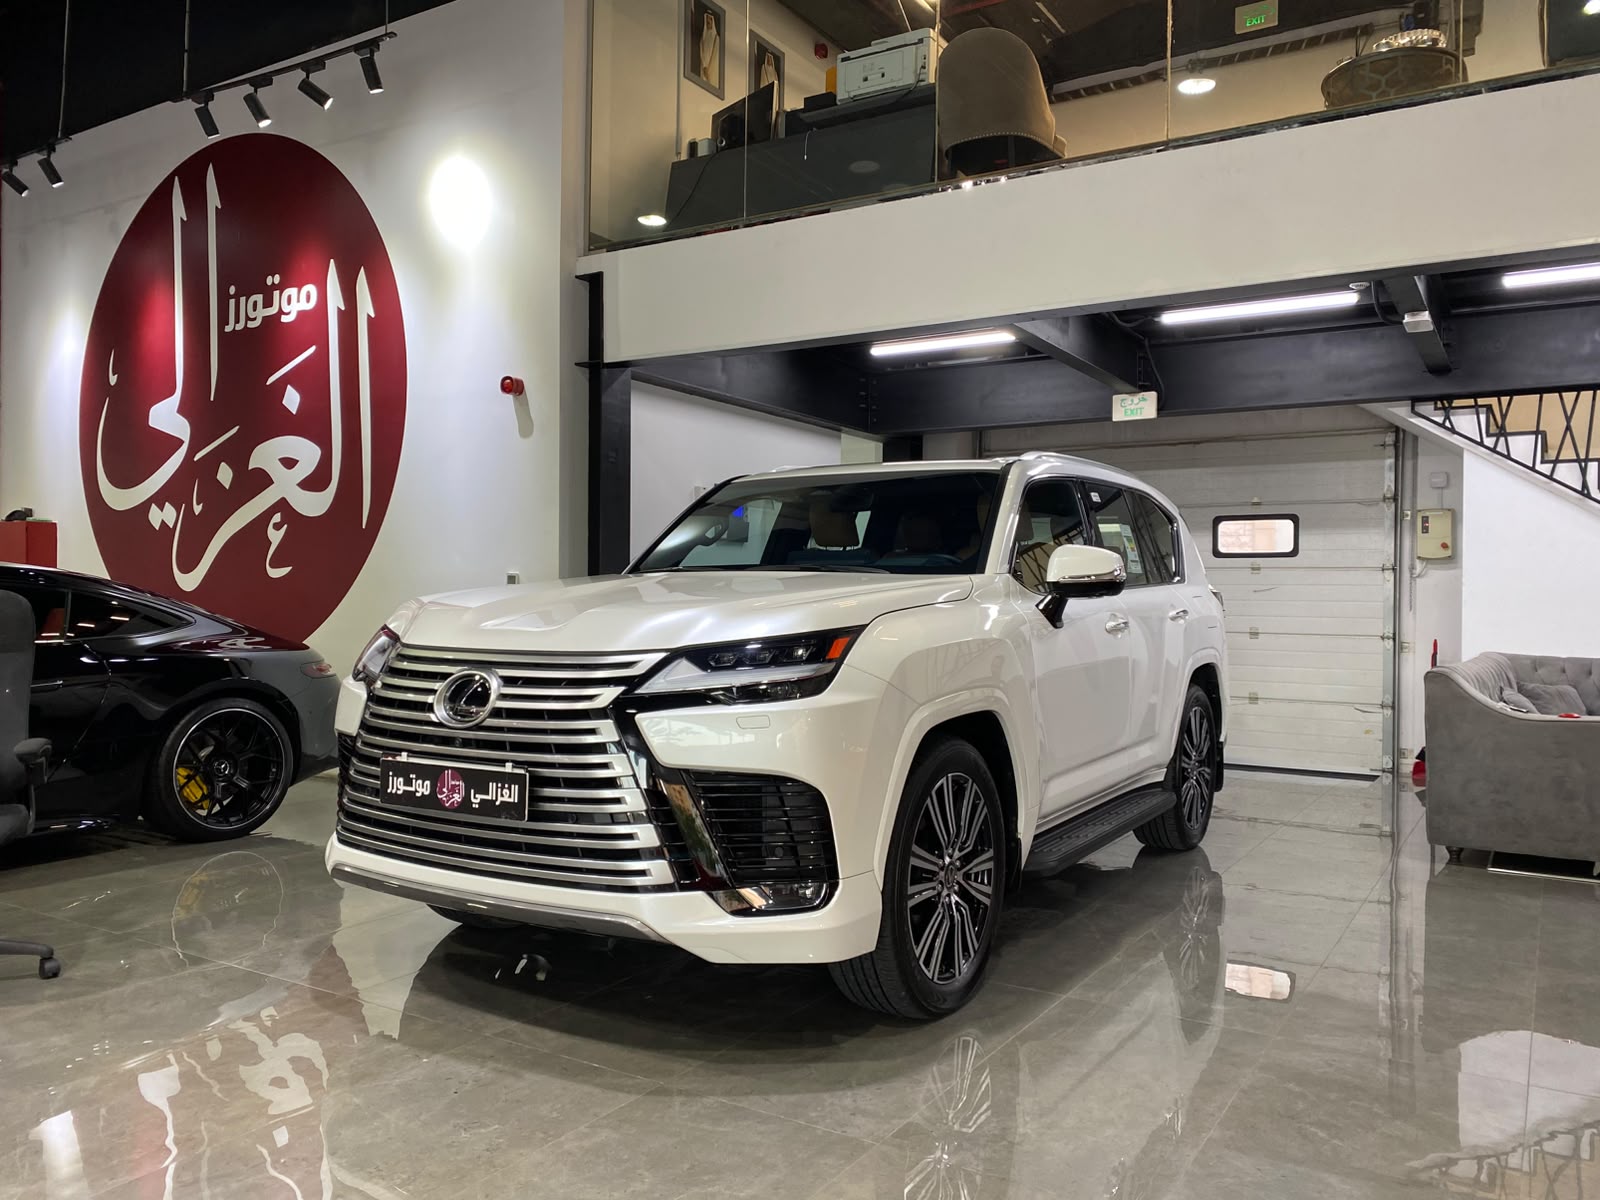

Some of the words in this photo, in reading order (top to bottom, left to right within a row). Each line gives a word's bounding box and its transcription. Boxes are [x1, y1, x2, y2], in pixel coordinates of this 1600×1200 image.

[1246, 15, 1266, 26] EXIT
[224, 273, 318, 333] موتورز
[1120, 395, 1148, 408] خروج
[1123, 407, 1145, 417] EXIT
[387, 771, 431, 797] موتورز
[470, 781, 519, 808] الغزالي
